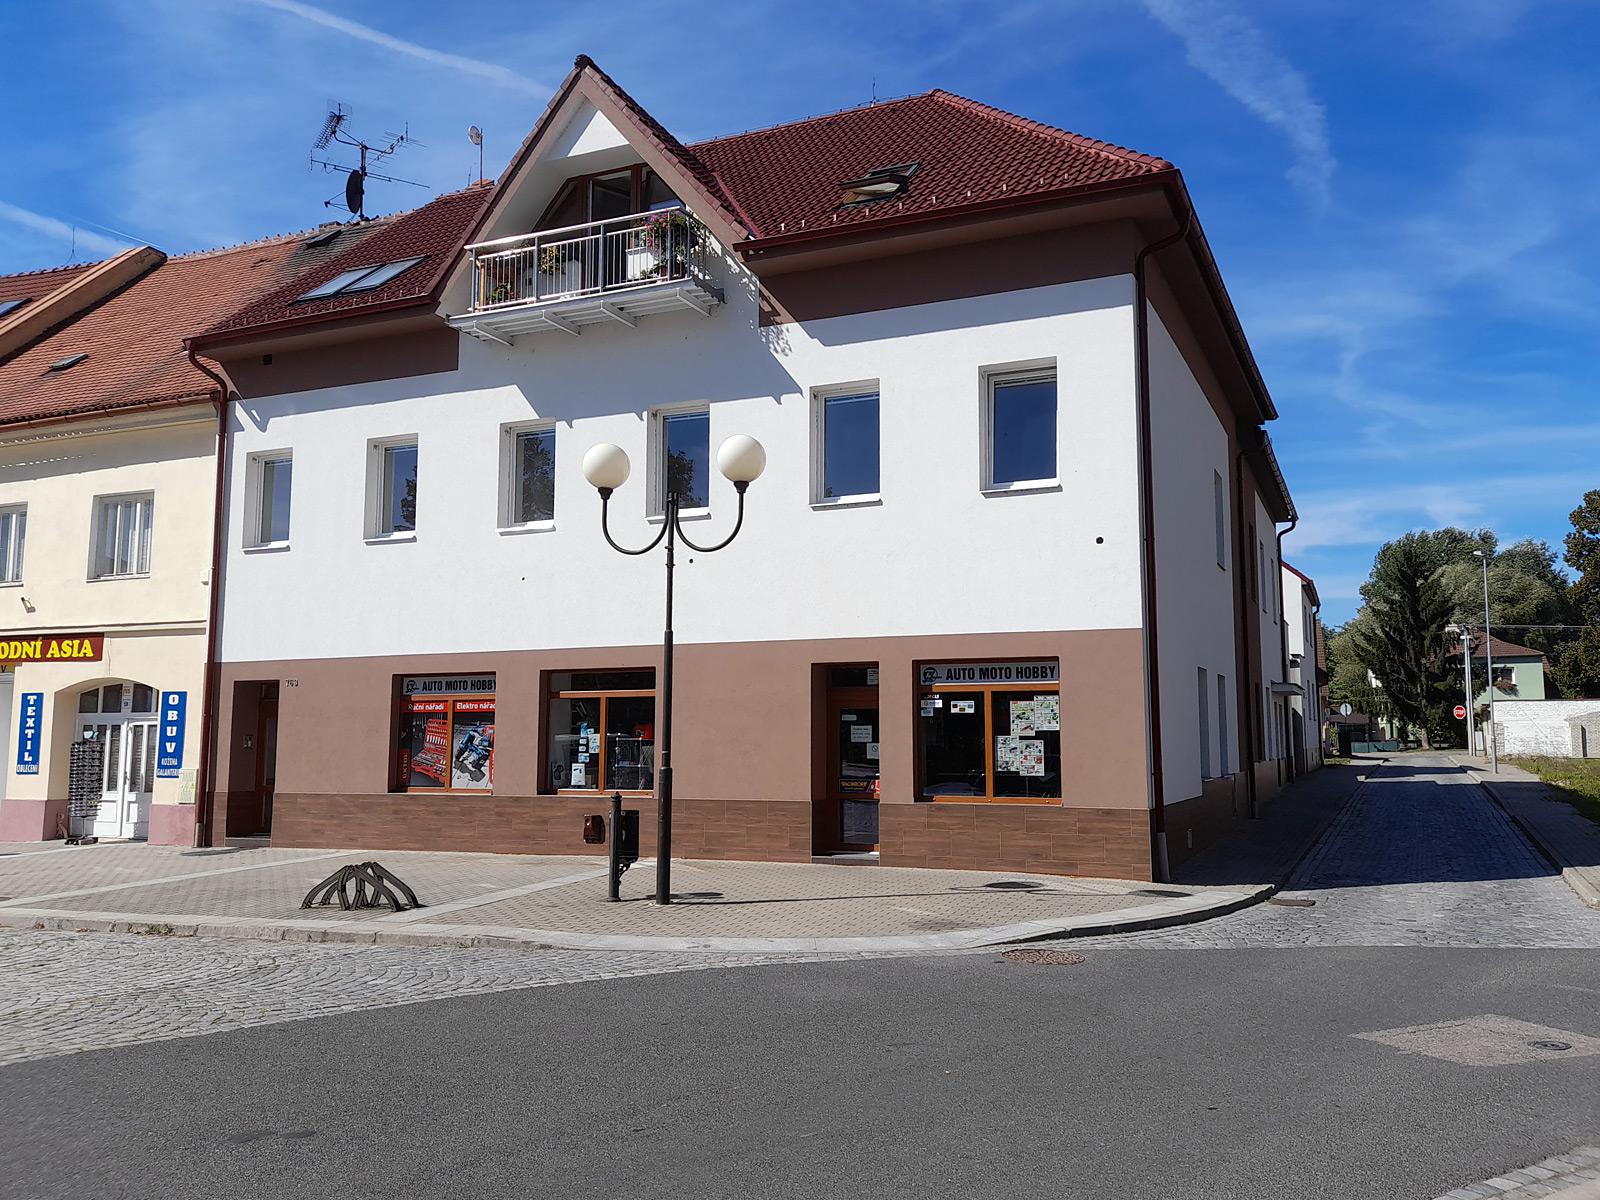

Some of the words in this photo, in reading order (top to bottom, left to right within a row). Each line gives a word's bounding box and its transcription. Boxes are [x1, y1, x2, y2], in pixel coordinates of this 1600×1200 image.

[46, 640, 94, 658] ASIA
[945, 668, 975, 681] AUTO
[979, 667, 1012, 680] MOTO
[1016, 665, 1056, 679] HOBBY
[422, 681, 442, 691] AUTO
[445, 680, 468, 690] MOTO
[457, 702, 478, 710] Elektro
[24, 695, 37, 762] TEXTIL
[165, 694, 180, 753] OBUV
